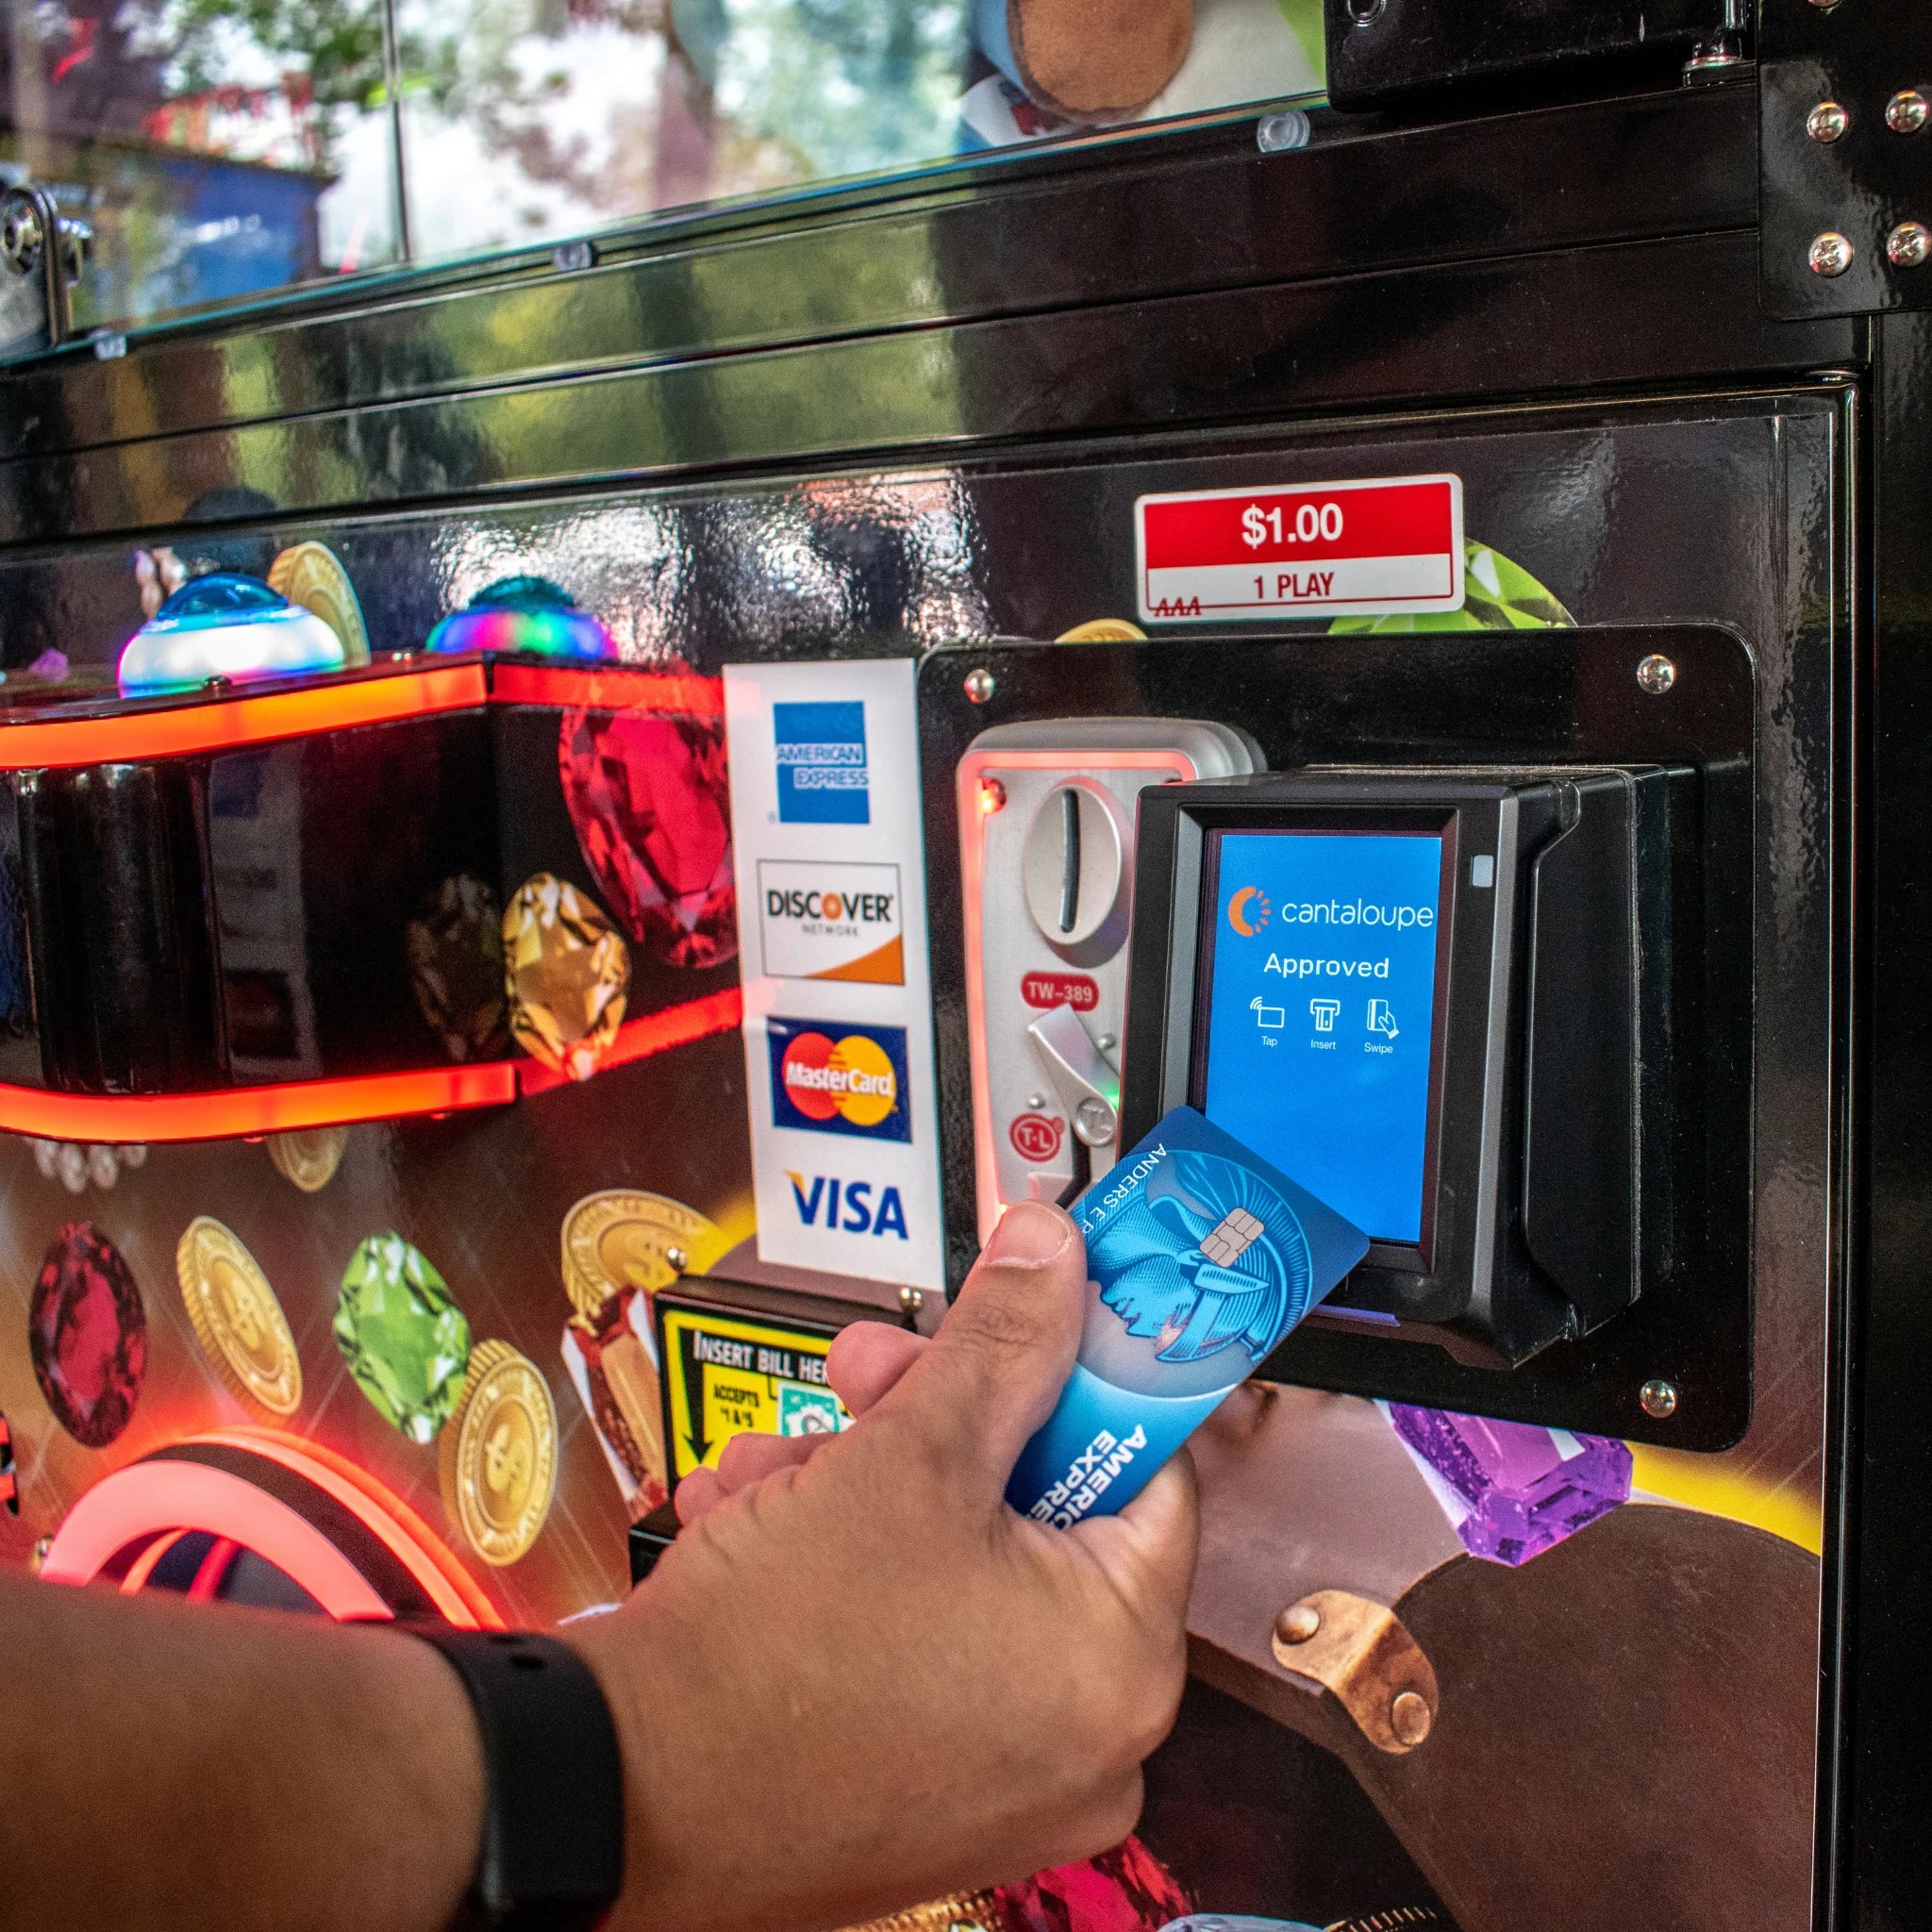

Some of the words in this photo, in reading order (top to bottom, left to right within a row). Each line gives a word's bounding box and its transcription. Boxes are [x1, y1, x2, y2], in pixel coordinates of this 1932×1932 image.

[1241, 503, 1342, 549] $1.00
[1254, 575, 1264, 599] 1
[1276, 572, 1334, 598] PLAY
[1154, 595, 1202, 617] AAA
[777, 745, 860, 761] AMERICAN
[797, 770, 869, 786] EXPRESS
[767, 890, 893, 923] DISCOVER
[1282, 898, 1434, 931] cantaloupe
[1263, 953, 1390, 978] Approved
[1027, 981, 1093, 1003] TW-389
[1261, 1036, 1277, 1047] Tap
[1310, 1040, 1336, 1051] Insert
[1364, 1042, 1393, 1055] Swipe
[785, 1062, 893, 1097] MasterCard
[1103, 1142, 1167, 1208] ANDERS
[784, 1169, 909, 1241] VISA
[1090, 1207, 1107, 1222] E
[758, 1347, 795, 1378] BILL
[798, 1355, 828, 1384] HE
[1029, 1429, 1118, 1524] EXPRE
[1050, 1424, 1147, 1530] AMERIC
